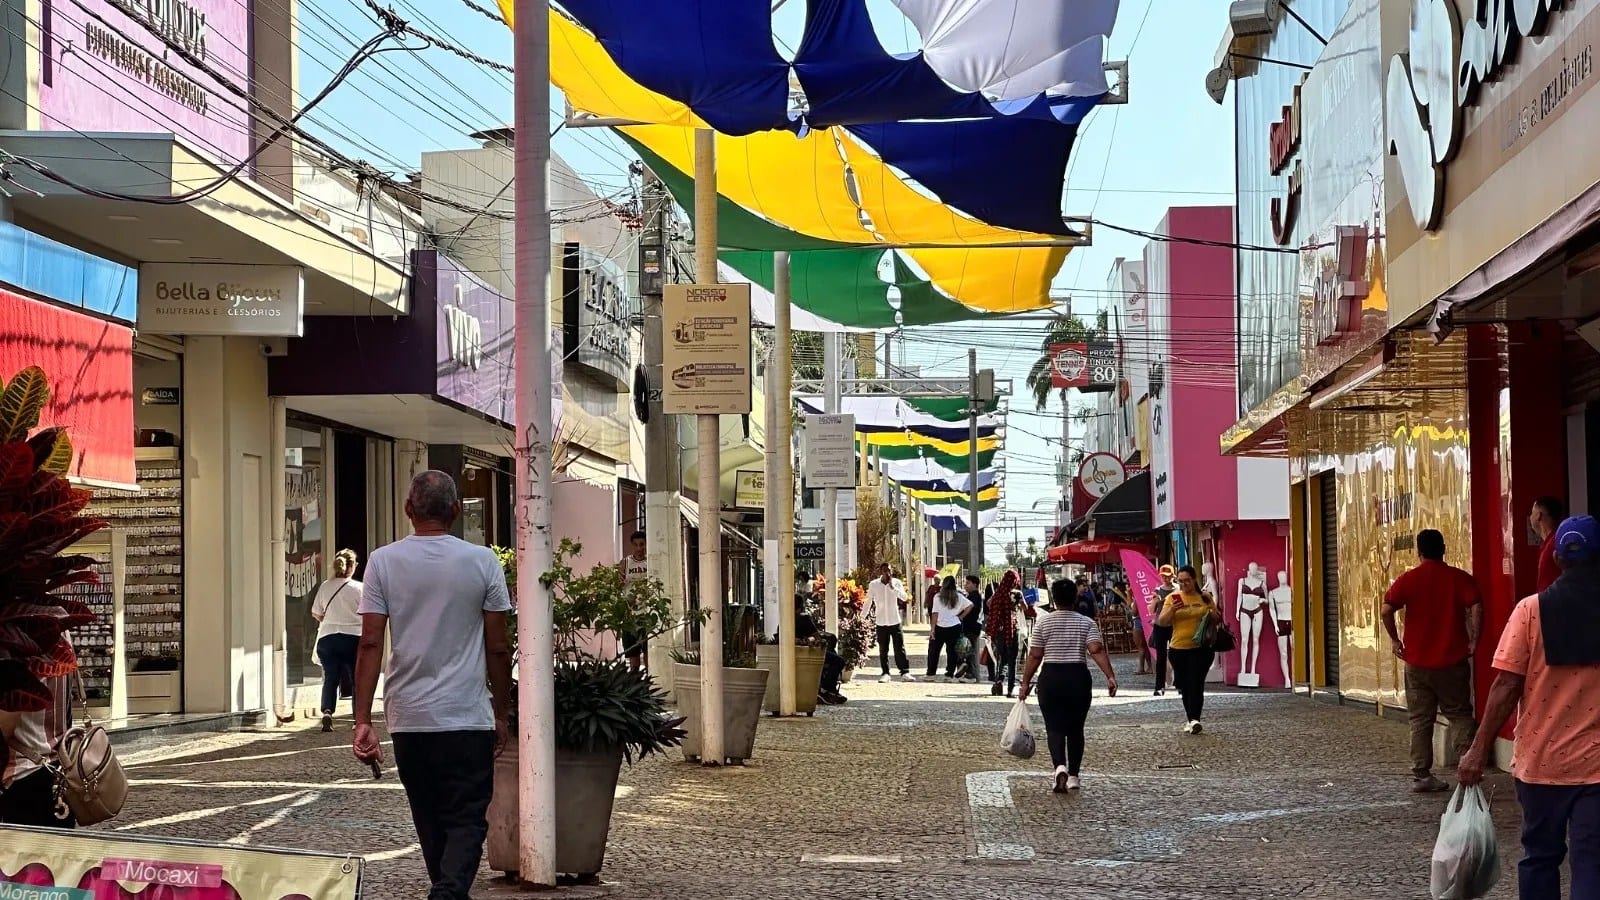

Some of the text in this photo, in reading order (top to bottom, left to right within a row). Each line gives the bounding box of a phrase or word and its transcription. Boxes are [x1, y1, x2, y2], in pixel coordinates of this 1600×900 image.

[156, 281, 210, 301] Bella
[687, 288, 726, 296] NOSSO
[156, 307, 281, 317] BIJUTERIAS E CESSÓRIOS
[1094, 367, 1116, 382] 80
[124, 860, 200, 885] Mocaxi
[0, 885, 69, 900] Morango
